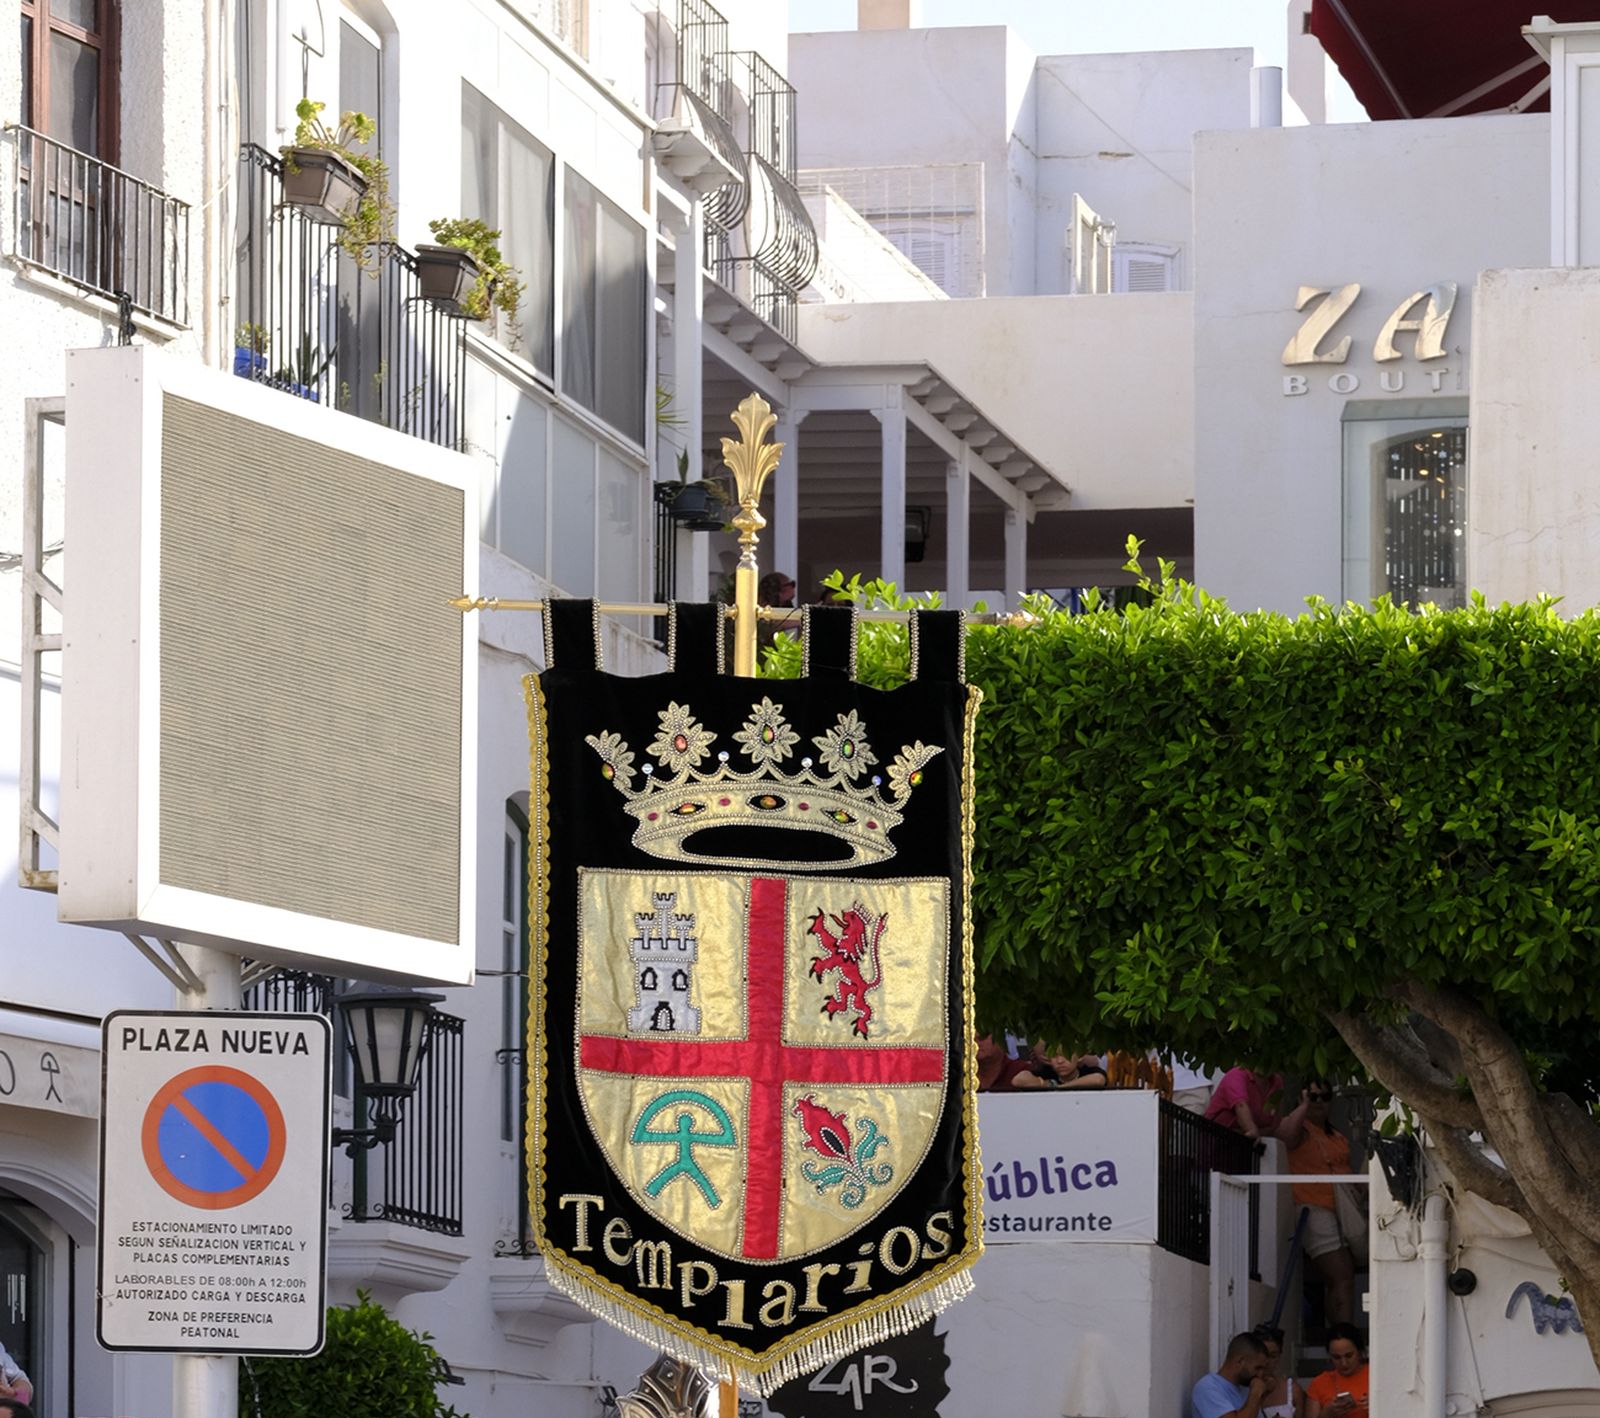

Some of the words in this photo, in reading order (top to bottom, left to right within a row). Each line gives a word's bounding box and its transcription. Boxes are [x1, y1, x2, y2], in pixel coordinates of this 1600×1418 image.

[1281, 281, 1458, 366] ZA
[121, 1027, 209, 1054] PLAZA
[221, 1029, 310, 1056] NUEVA
[132, 1221, 238, 1235] ESTACIONAMIENTO
[240, 1225, 293, 1236] LIMITADO
[117, 1237, 155, 1248] SEGUN
[158, 1236, 239, 1251] SEÑALIZACION
[242, 1240, 295, 1252] VERTICAL
[299, 1241, 307, 1252] Y
[133, 1253, 178, 1264] PLACAS
[182, 1254, 290, 1267] COMPLEMENTARIAS
[558, 1192, 956, 1332] Templarios
[114, 1274, 196, 1286] LABORABLES
[199, 1276, 215, 1286] DE
[218, 1277, 256, 1288] 08:00h
[258, 1277, 268, 1287] A
[270, 1278, 307, 1289] 12:00h
[115, 1289, 187, 1301] AUTORIZADO
[191, 1290, 231, 1302] CARGA
[235, 1292, 242, 1302] Y
[246, 1292, 306, 1304] DESCARGA
[147, 1311, 179, 1322] ZONA
[183, 1312, 197, 1323] DE
[200, 1313, 274, 1325] PREFERENCIA
[180, 1327, 240, 1339] PEATONAL
